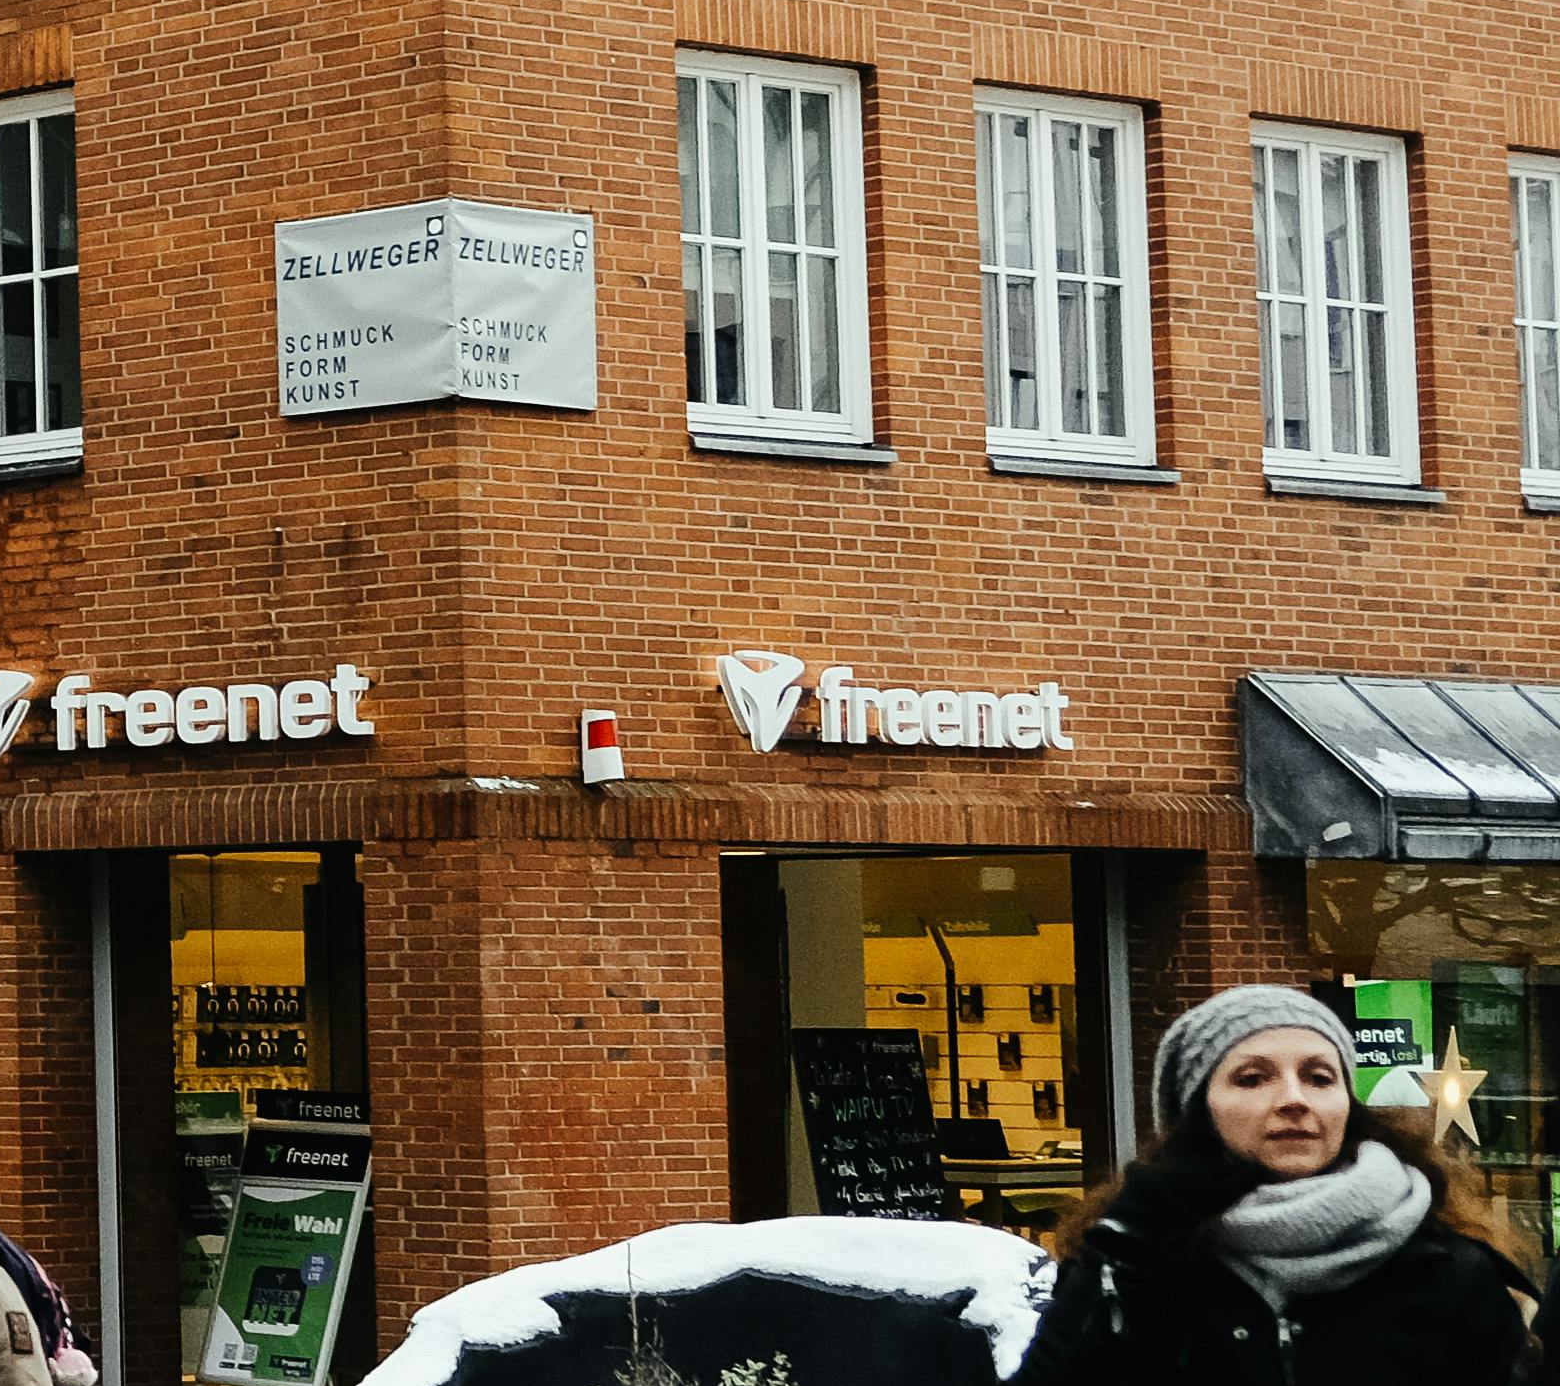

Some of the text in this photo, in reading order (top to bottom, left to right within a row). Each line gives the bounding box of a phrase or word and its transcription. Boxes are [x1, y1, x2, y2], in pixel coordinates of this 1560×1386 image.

[282, 237, 440, 281] ZELLWEGER
[458, 236, 585, 273] ZELLWEGER
[285, 324, 395, 354] SCHMUCK
[460, 317, 548, 344] SCHMUCK
[461, 342, 511, 365] FORM
[285, 355, 347, 380] FORM
[462, 368, 520, 391] KUNST
[286, 379, 361, 405] KUNST
[51, 663, 376, 751] freenet
[816, 666, 1075, 751] freenet
[298, 1100, 362, 1120] freenet
[831, 1096, 885, 1122] WAIPU
[184, 1152, 233, 1168] freenet
[286, 1147, 350, 1167] freenet
[294, 1214, 344, 1235] Wahl
